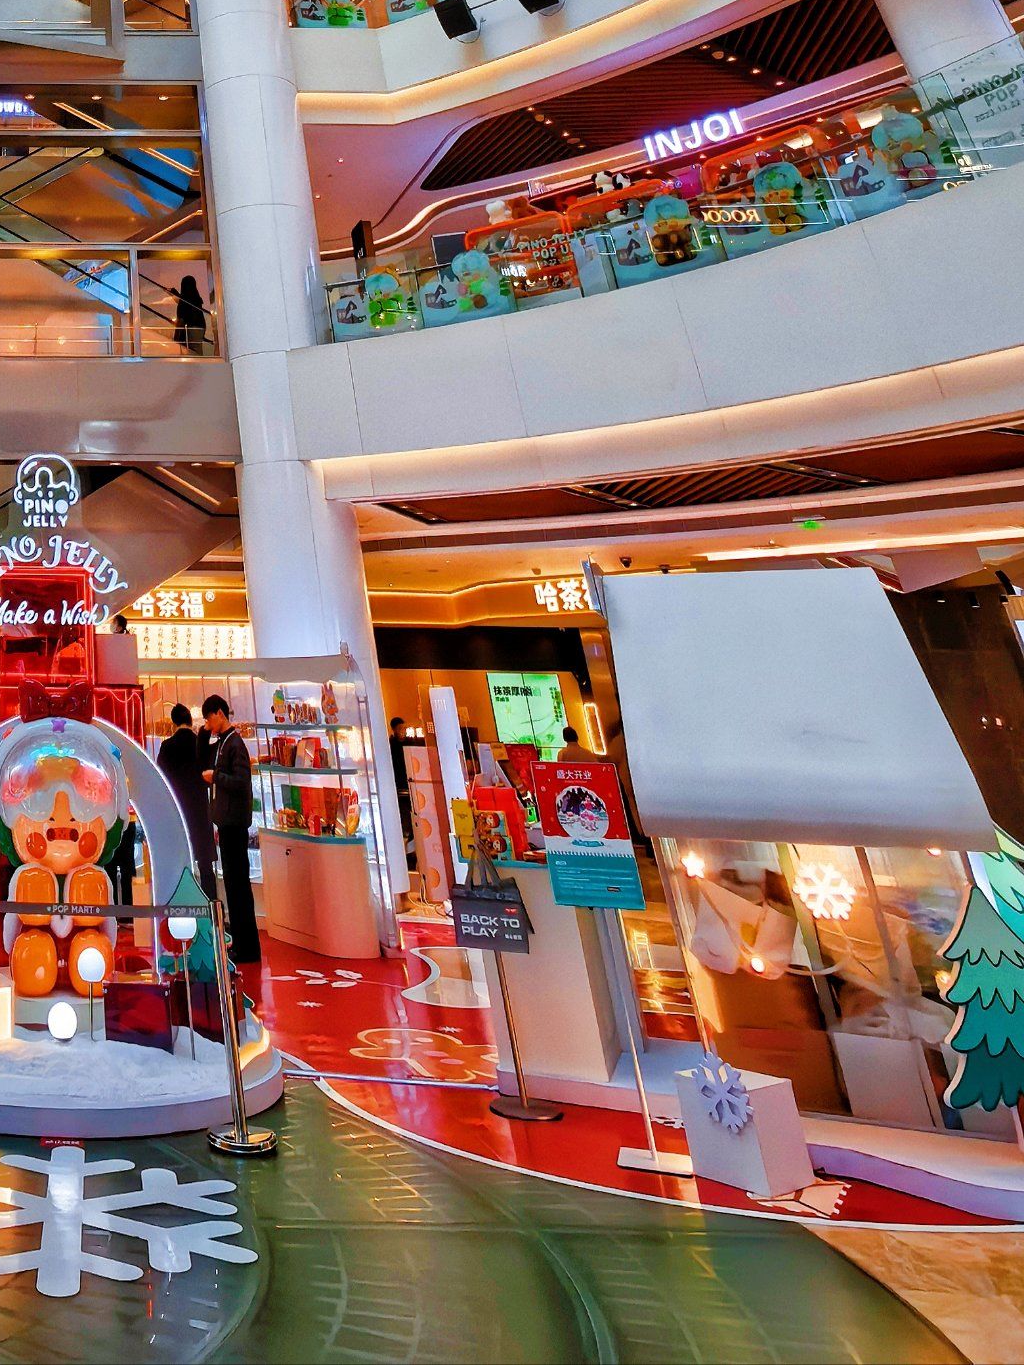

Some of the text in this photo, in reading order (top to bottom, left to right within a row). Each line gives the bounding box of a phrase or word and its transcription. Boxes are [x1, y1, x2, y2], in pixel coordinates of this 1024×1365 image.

[643, 107, 744, 161] INJOI
[24, 499, 69, 514] PINO
[22, 515, 69, 528] JELLY
[42, 535, 129, 595] JELLY
[132, 590, 205, 619] 哈茶福
[43, 609, 57, 625] a
[60, 599, 110, 627] Wish
[52, 906, 95, 915] POP MART
[169, 907, 187, 915] POP
[460, 914, 520, 929] BACK TO
[461, 925, 498, 938] PLAY
